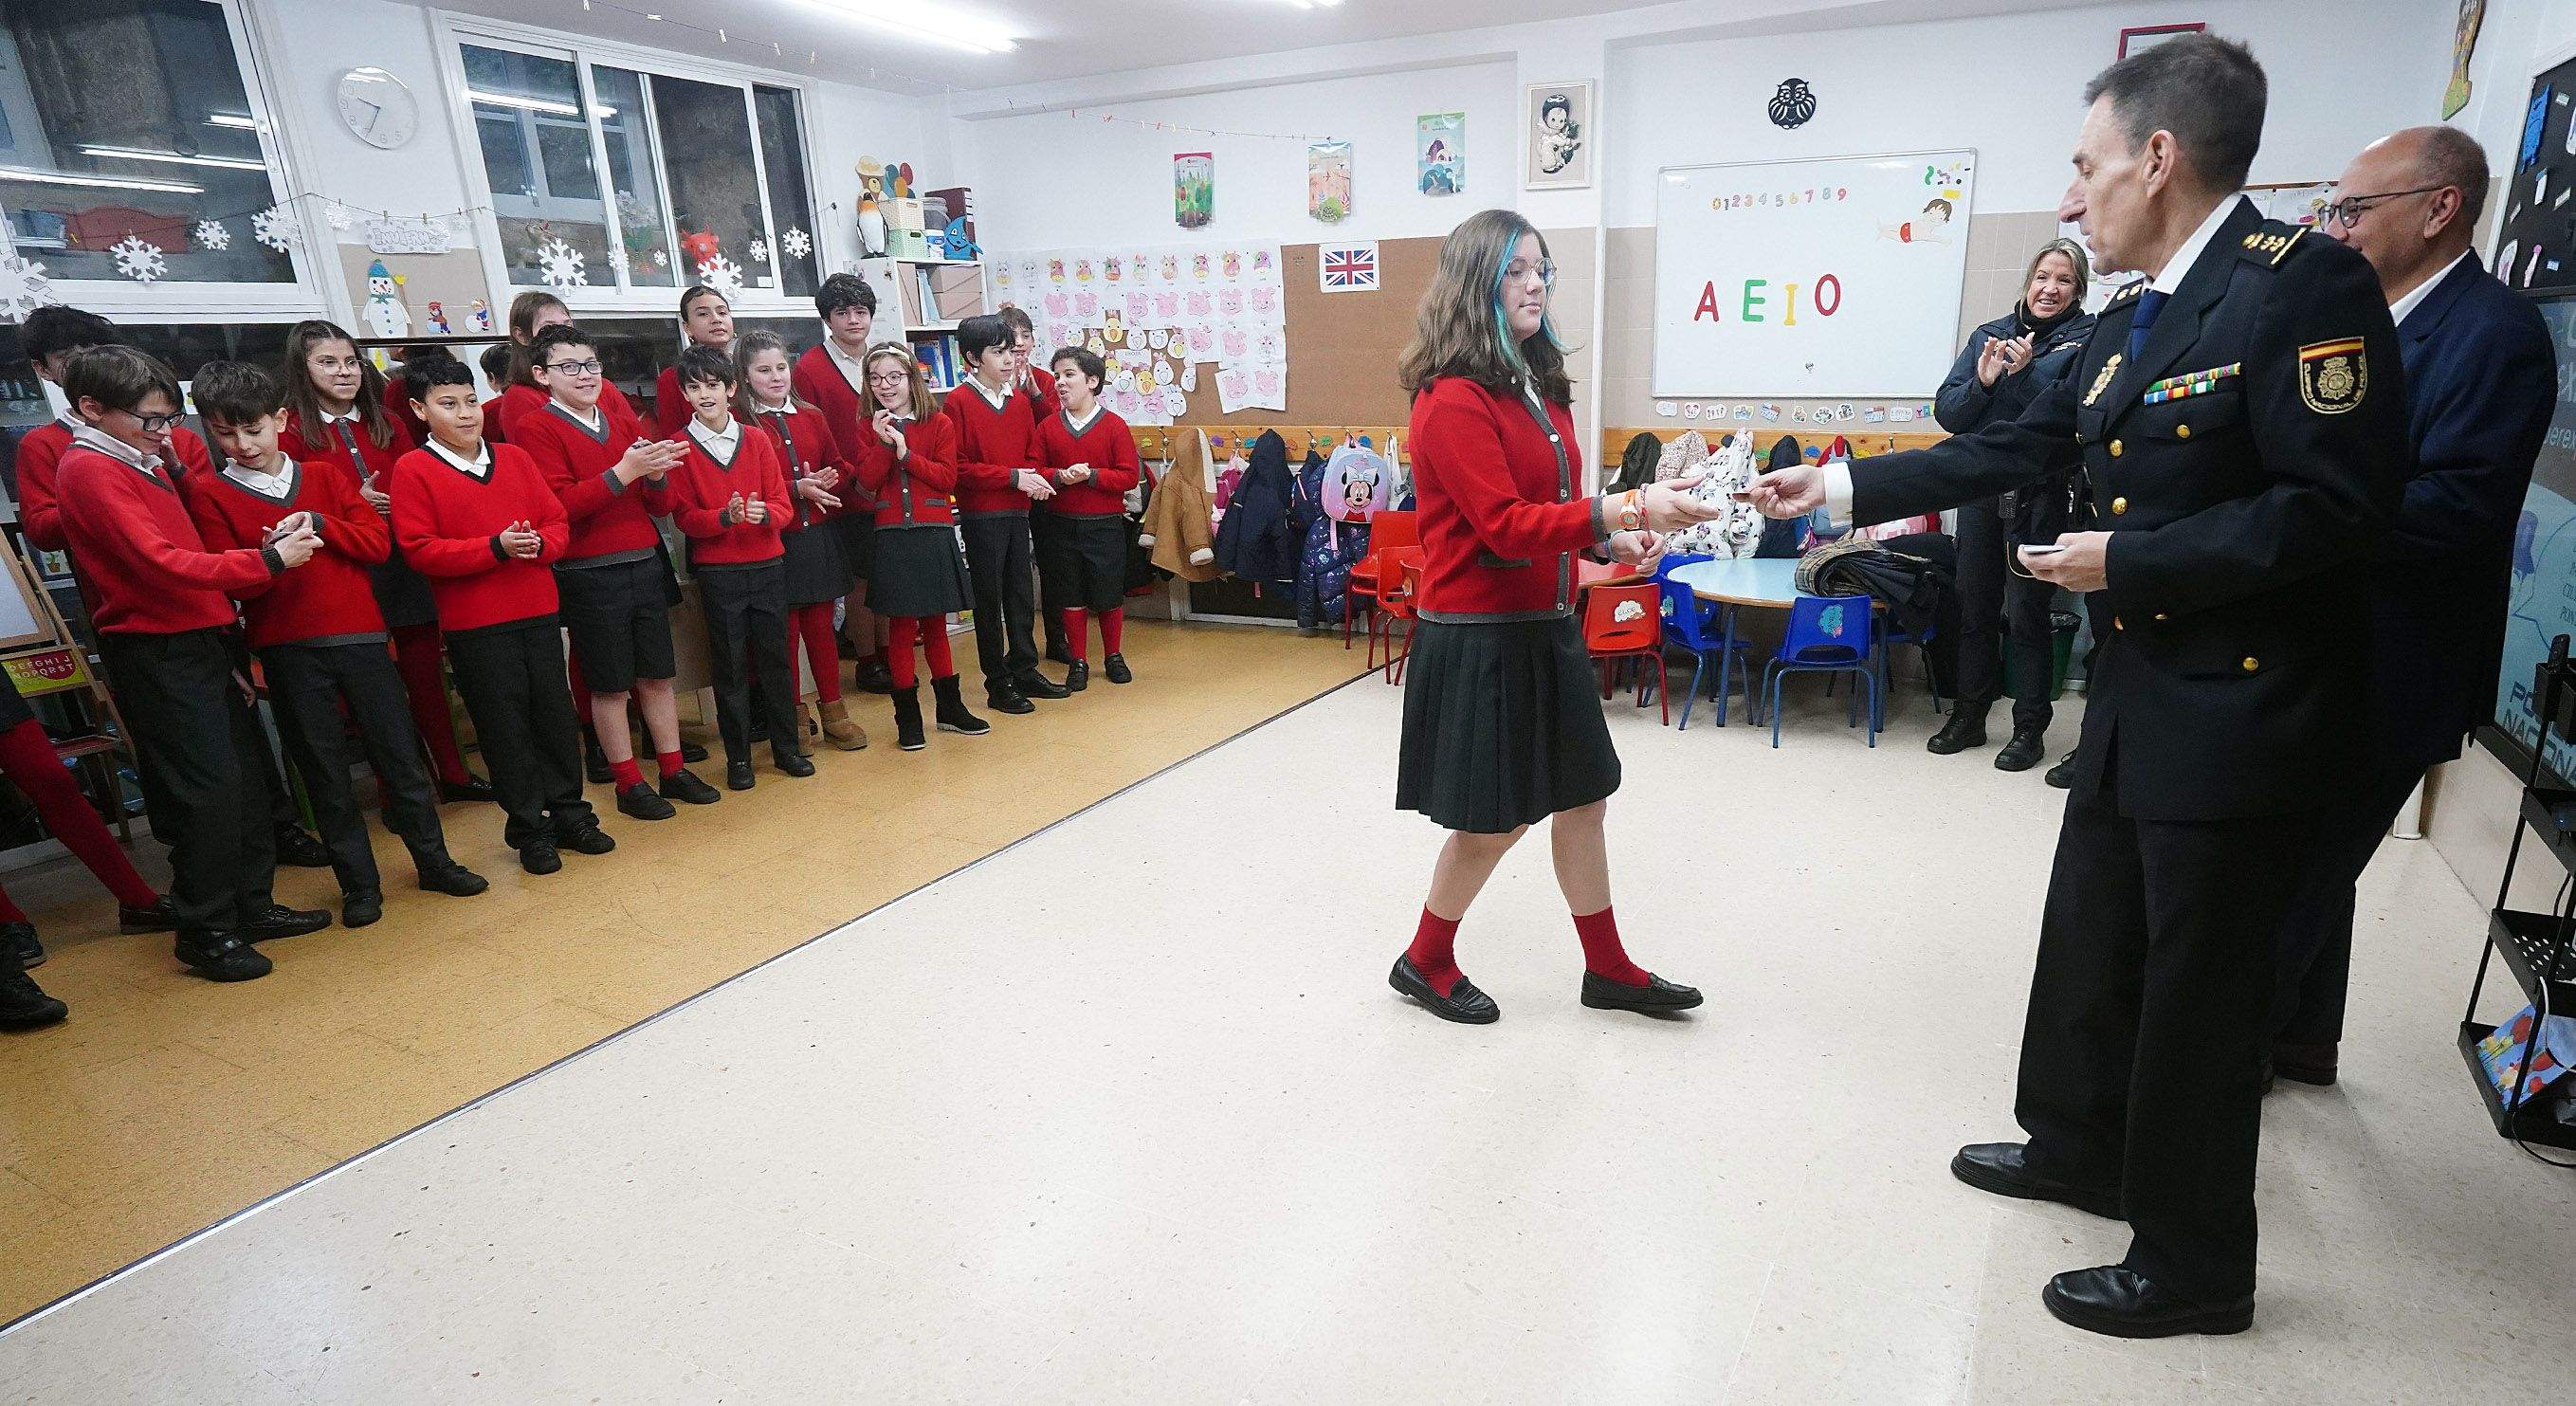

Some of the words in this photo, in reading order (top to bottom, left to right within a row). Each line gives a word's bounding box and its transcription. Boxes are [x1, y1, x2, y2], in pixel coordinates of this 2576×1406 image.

[1693, 281, 1720, 322] A
[1742, 279, 1767, 322] E
[1783, 283, 1800, 326] I
[1814, 273, 1841, 317] O
